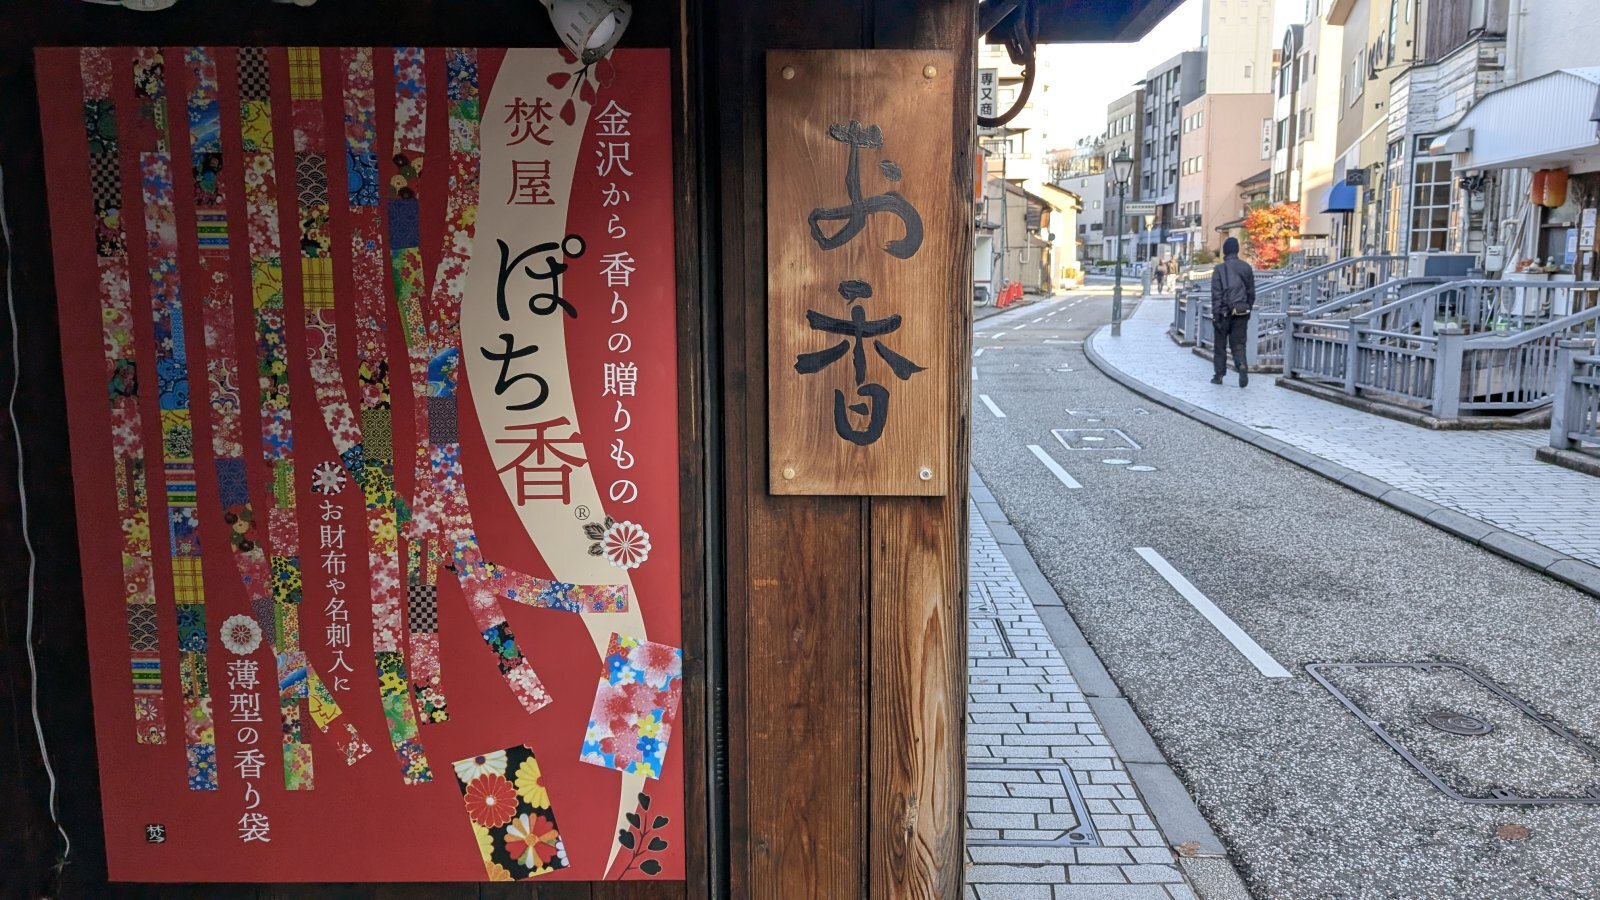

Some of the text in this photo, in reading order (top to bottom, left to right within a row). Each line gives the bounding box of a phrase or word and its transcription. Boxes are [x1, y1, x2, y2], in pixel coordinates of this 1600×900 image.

[980, 73, 993, 131] 専又商
[594, 99, 639, 504] 金沢から香りの贈りもの
[794, 119, 929, 446] お香
[318, 499, 355, 692] お財布や名刺入に
[226, 659, 272, 843] 薄型の香り袋
